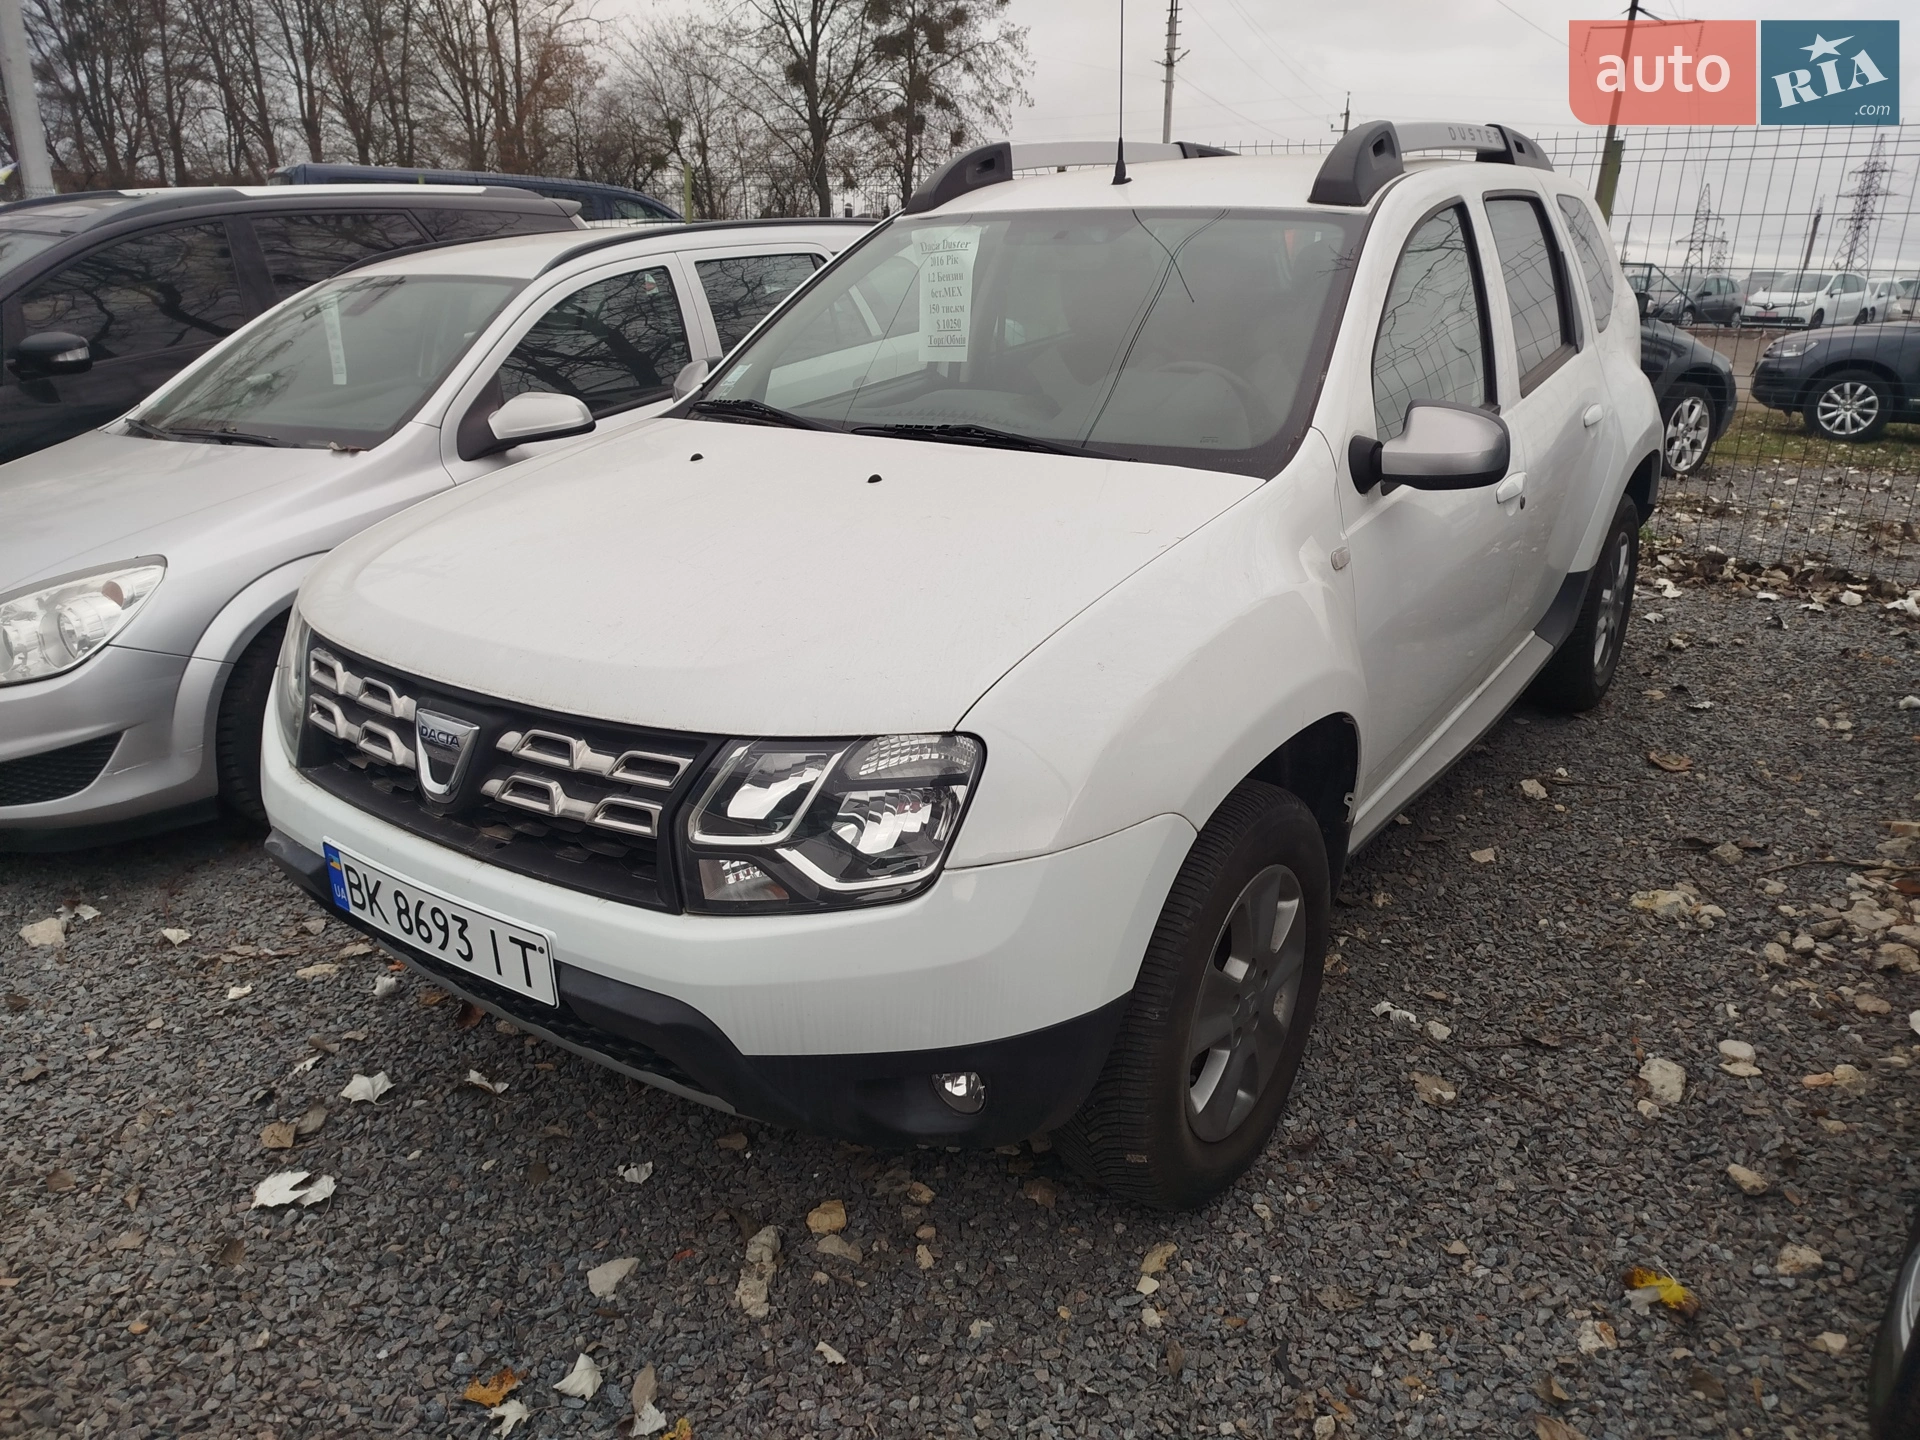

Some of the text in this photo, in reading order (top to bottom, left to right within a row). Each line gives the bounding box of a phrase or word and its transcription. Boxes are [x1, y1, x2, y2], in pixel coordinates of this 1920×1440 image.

[1447, 126, 1502, 145] DUSTER
[920, 239, 971, 252] Dacia Duster
[930, 254, 959, 267] 2016 Рік
[927, 271, 964, 283] 1.2 Бензин
[929, 303, 940, 315] 150
[942, 318, 962, 330] 10250
[420, 725, 460, 748] DACIA
[333, 883, 348, 902] UA
[344, 863, 538, 989] BK 8693 IT
